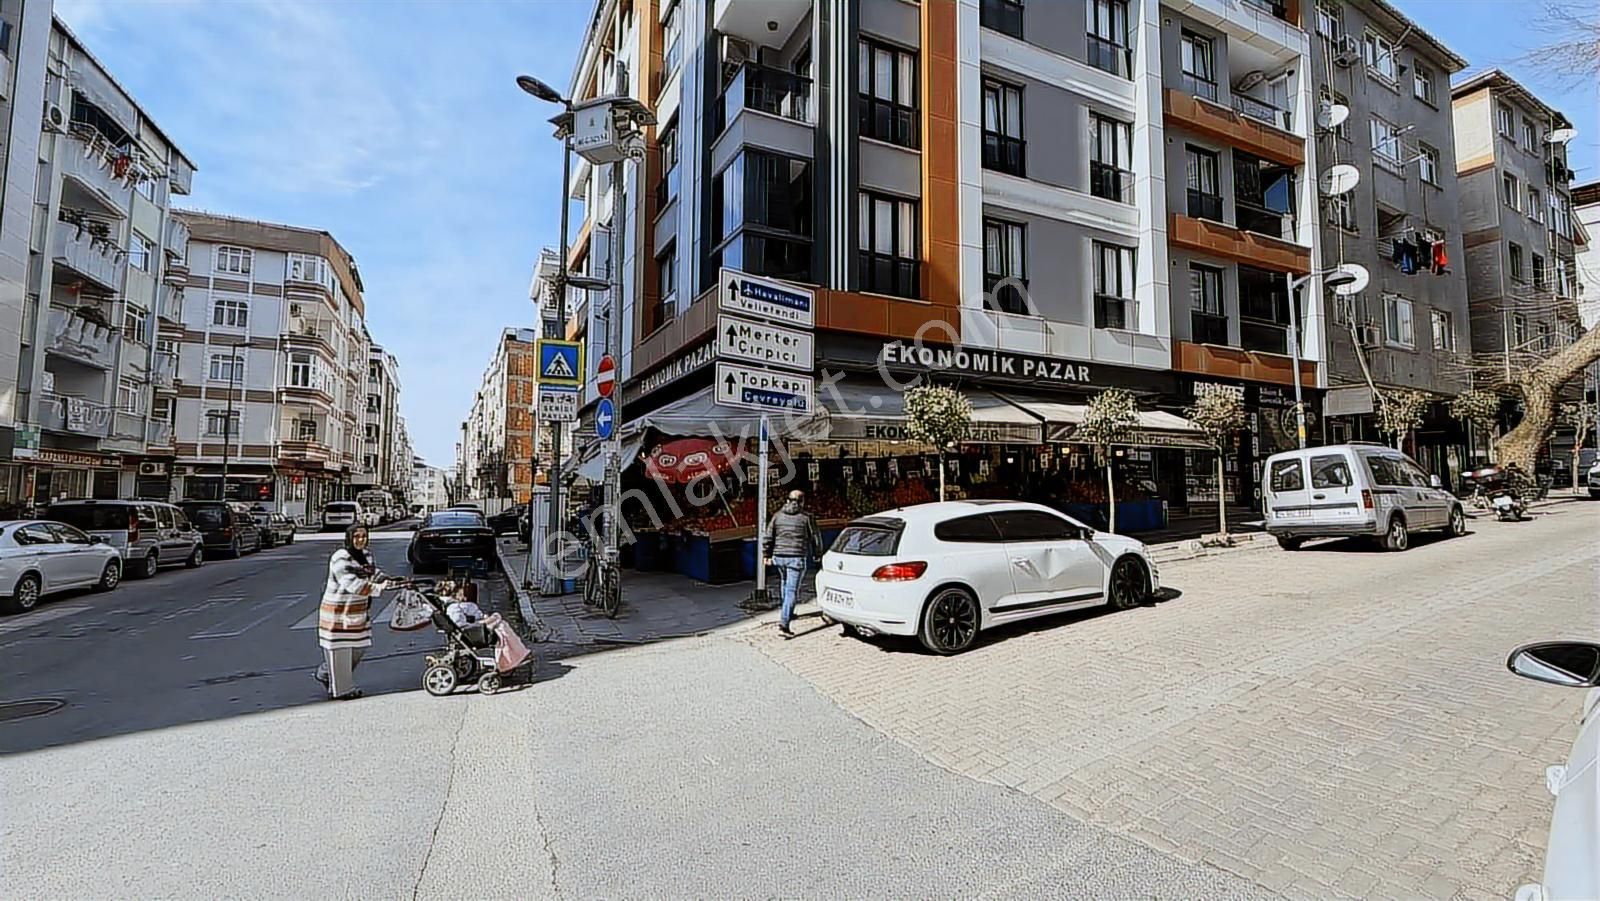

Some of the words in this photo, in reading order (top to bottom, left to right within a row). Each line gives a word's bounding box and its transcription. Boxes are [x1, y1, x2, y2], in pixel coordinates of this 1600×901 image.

[740, 299, 799, 320] Veliefendi
[739, 325, 799, 347] Merter
[738, 340, 796, 363] Çırpıcı
[882, 343, 1015, 375] EKONOMİK
[1023, 359, 1091, 382] PAZAR
[641, 358, 682, 394] EKONOMİK
[684, 339, 719, 373] PAZAR
[740, 371, 806, 392] Topkapı
